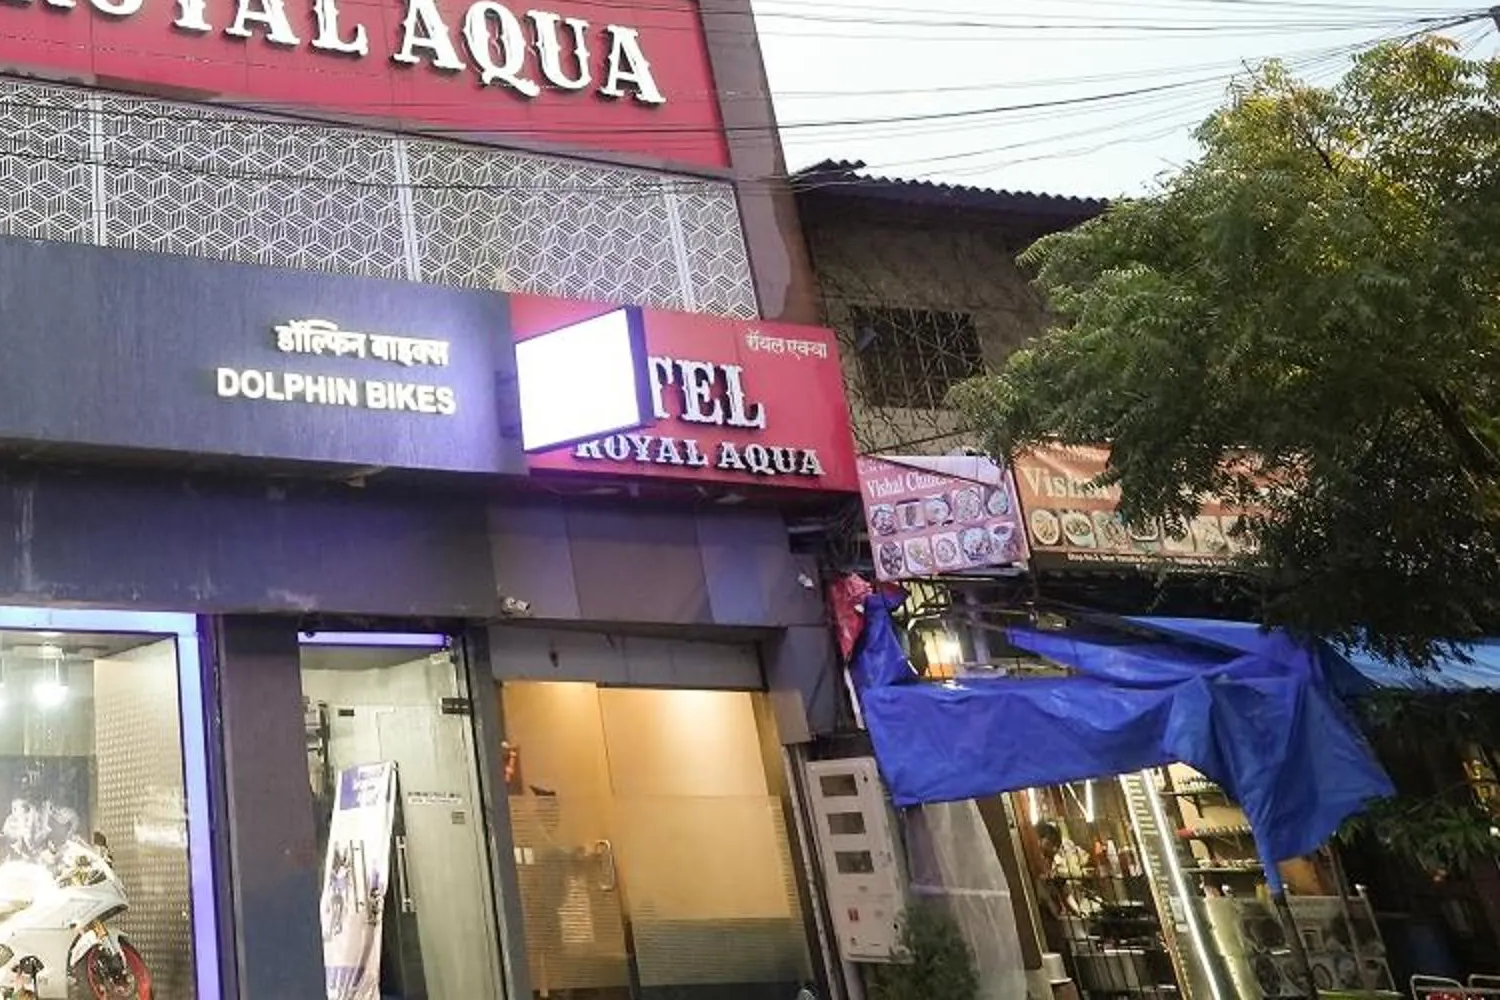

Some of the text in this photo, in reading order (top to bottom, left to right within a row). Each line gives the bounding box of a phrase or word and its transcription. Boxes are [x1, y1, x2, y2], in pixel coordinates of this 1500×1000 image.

[274, 318, 451, 366] डॉल्फिन बाइक्स
[216, 367, 457, 415] DOLPHIN BIKES
[647, 355, 767, 429] TEL
[573, 434, 709, 466] ROYAL
[717, 441, 826, 476] AQUA
